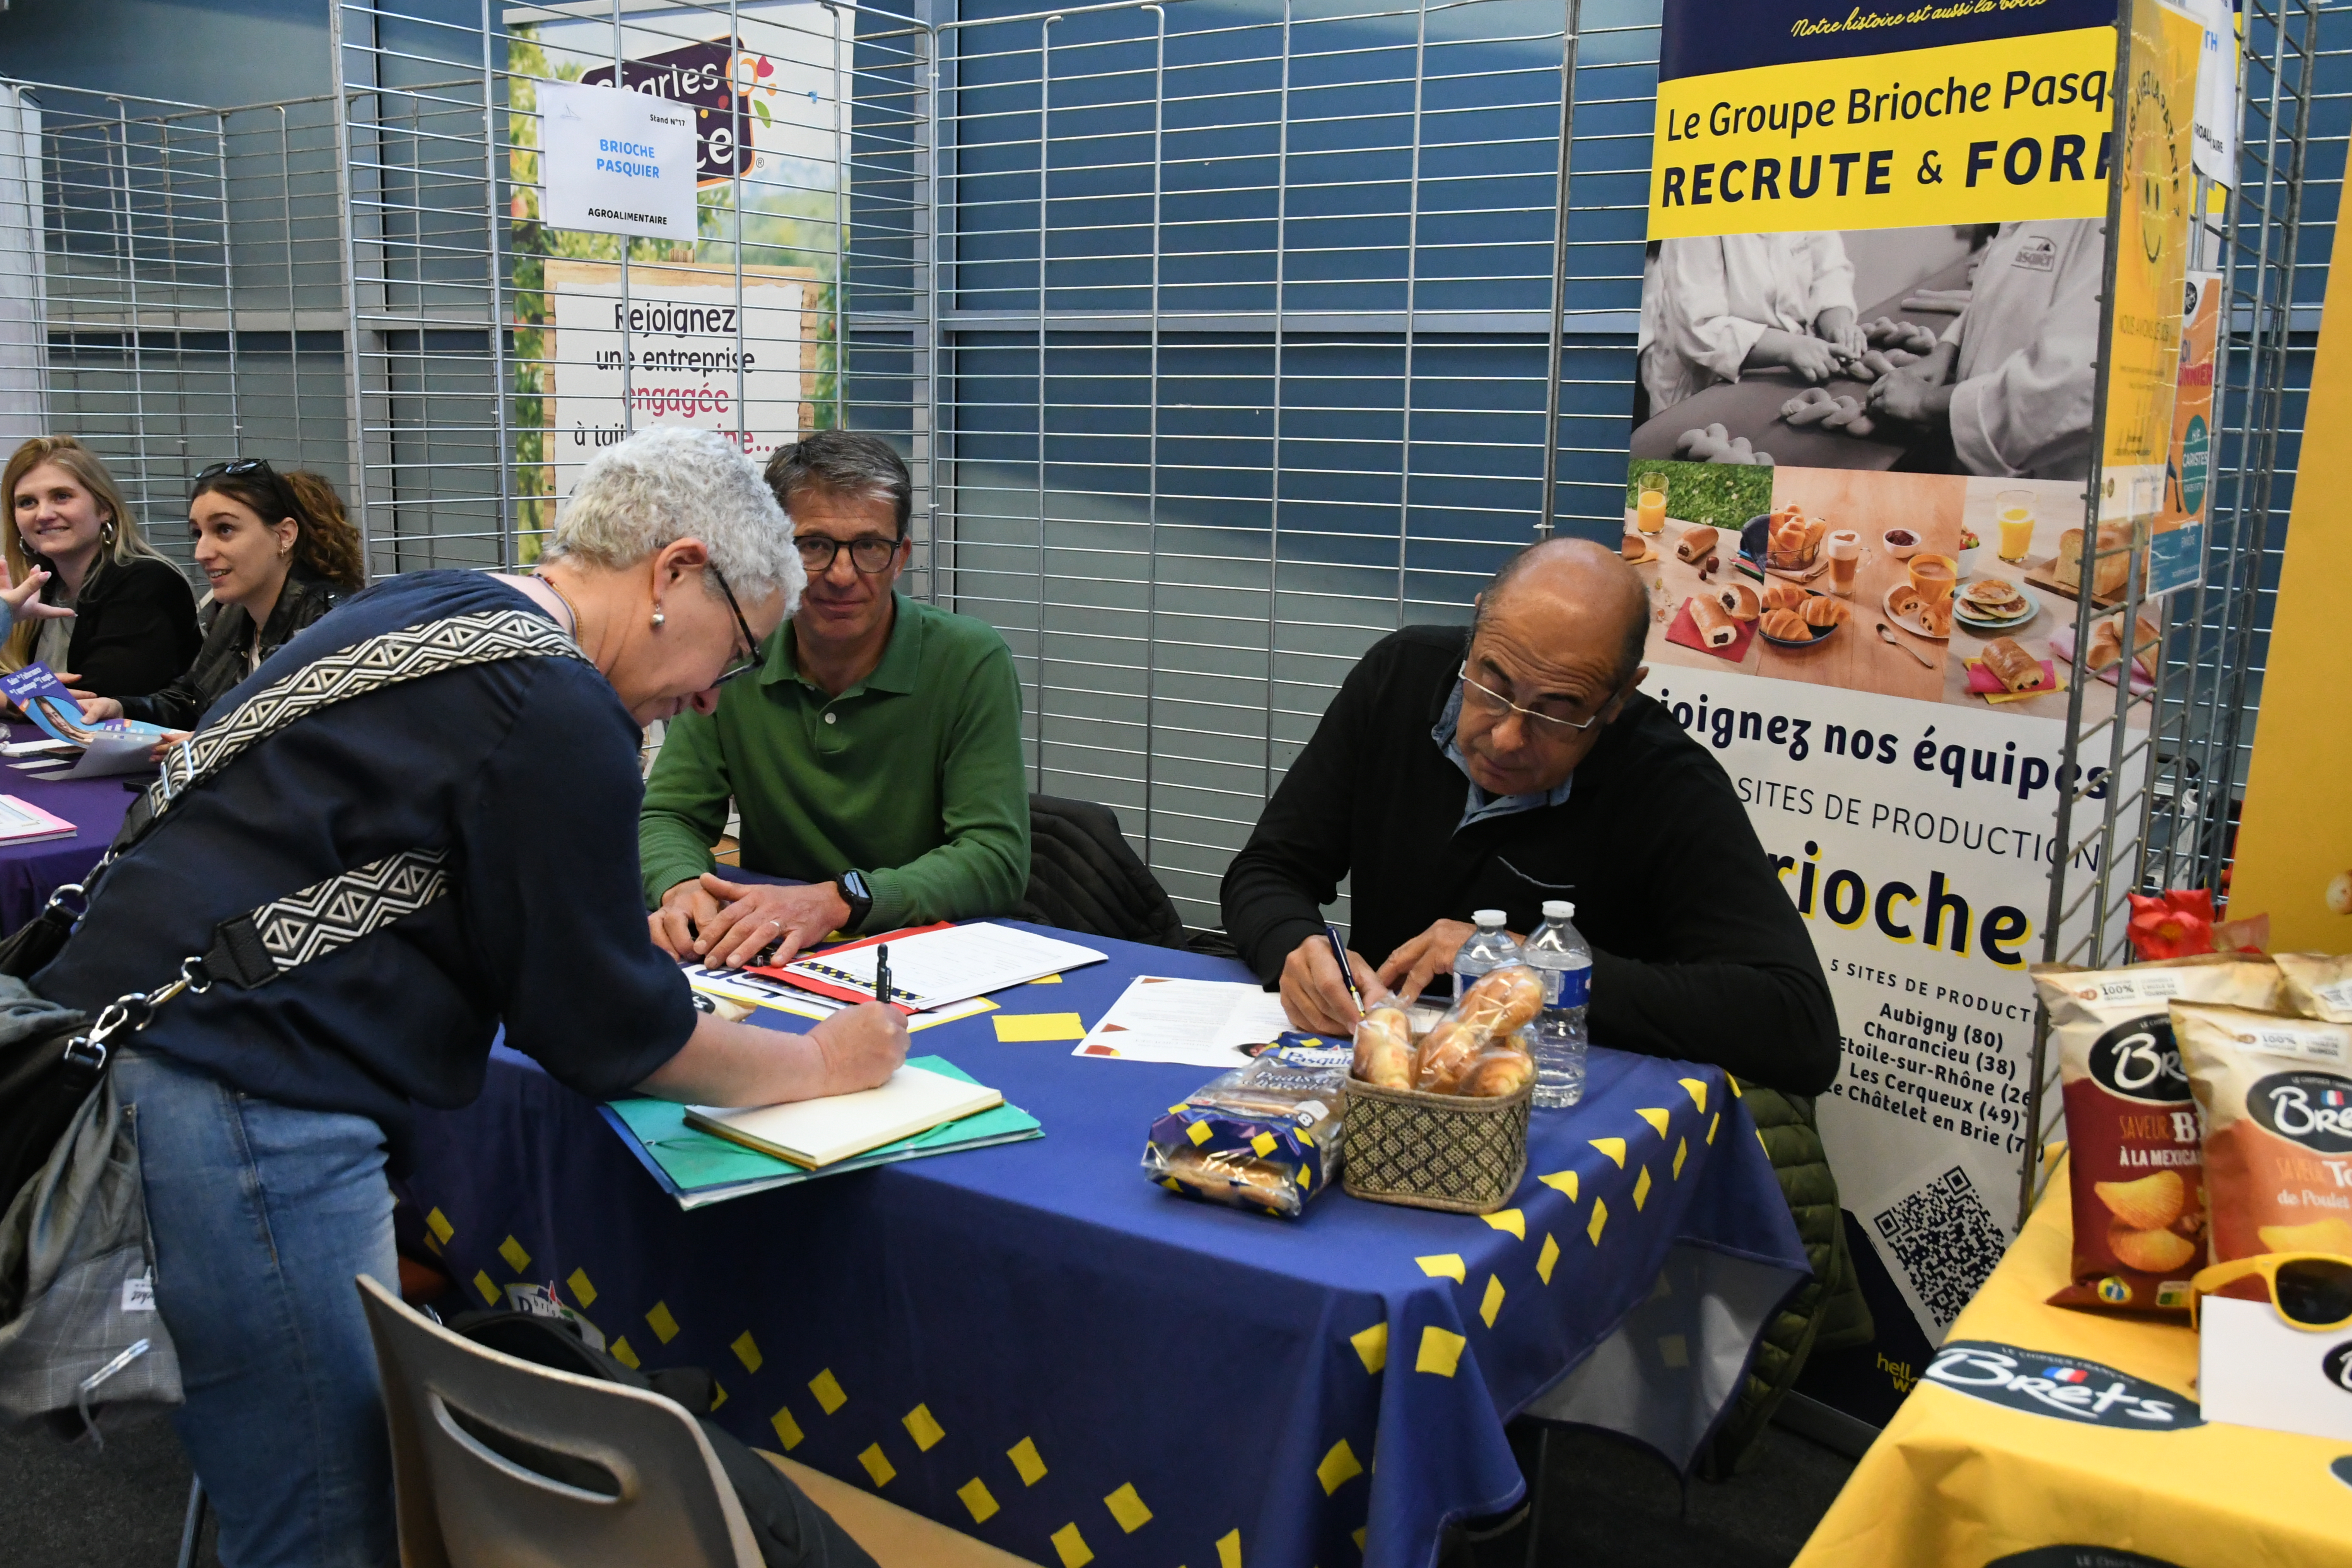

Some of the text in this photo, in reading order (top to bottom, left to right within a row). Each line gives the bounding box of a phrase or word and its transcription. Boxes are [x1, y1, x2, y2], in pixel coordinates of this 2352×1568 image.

[1791, 19, 1842, 37] Notre
[1842, 6, 1906, 31] histoire
[1907, 5, 1932, 23] est
[1932, 0, 1974, 19] aussi
[650, 114, 686, 126] Stand N°17
[1668, 70, 2107, 142] Le Groupe Brioche Pasq
[599, 139, 655, 158] BRIOCHE
[596, 158, 660, 179] PASQUIER
[1662, 150, 1893, 208] RECRUTE
[1917, 150, 1943, 184] &
[588, 208, 667, 225] AGROALIMENTAIRE
[615, 302, 737, 338] Rejoignez
[596, 347, 755, 378] une entreprise
[623, 381, 730, 418] engagée
[574, 420, 586, 446] à
[1661, 688, 1811, 761] oignez
[1825, 724, 1897, 765] nos
[1738, 777, 1814, 815] SITES
[1825, 794, 1862, 825] DE
[1767, 841, 2029, 967] rioche
[1830, 959, 2038, 1025] 5 SITES DE PRODUCT
[2102, 984, 2134, 995] 100%
[1879, 1003, 2003, 1054] Aubigny (80)
[1864, 1021, 2015, 1081] Charancieu (38)
[2111, 1032, 2189, 1090] Br
[1850, 1062, 2019, 1131] Les Cerqueux (49)
[2001, 1082, 2031, 1106] (26
[1826, 1083, 1843, 1096] e
[1848, 1085, 1927, 1123] Châtelet
[1932, 1114, 1954, 1132] en
[1960, 1119, 2000, 1146] Brie
[2119, 1115, 2170, 1140] SAVEUR
[2120, 1145, 2202, 1167] À LA MEXICA
[2277, 1189, 2350, 1209] de Poulet
